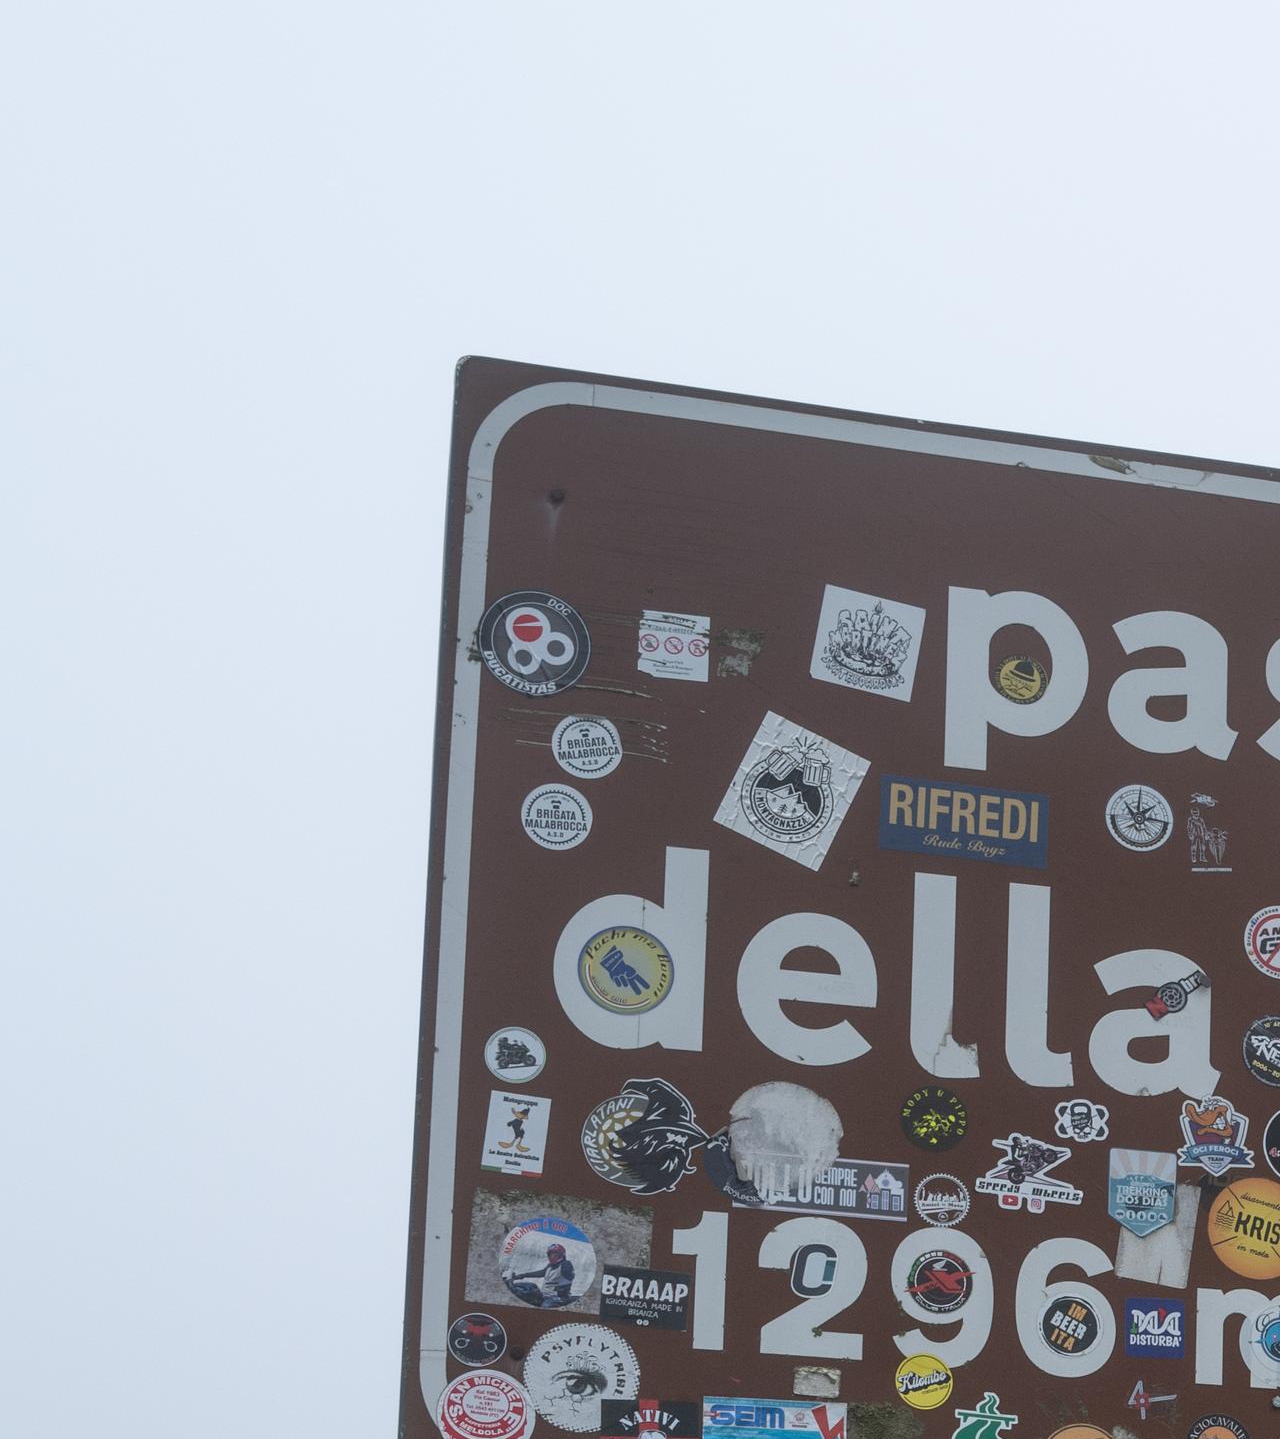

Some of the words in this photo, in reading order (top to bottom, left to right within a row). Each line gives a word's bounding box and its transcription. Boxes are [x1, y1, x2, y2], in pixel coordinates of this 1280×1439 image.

[483, 649, 558, 695] DUCATISTAS
[558, 745, 621, 760] MALABROCCA
[566, 736, 607, 749] BRIGATA
[536, 809, 577, 822] BRIGATA
[889, 781, 1040, 843] RIFREDI
[524, 818, 588, 832] MALABROCCA
[553, 846, 1222, 1100] della
[814, 1166, 858, 1189] SEMPRE
[814, 1184, 836, 1207] CON
[838, 1187, 857, 1208] NOI
[1117, 1185, 1168, 1199] TREKKING
[602, 1273, 689, 1302] BRAAAP
[672, 1210, 1116, 1378] 1296
[1050, 1311, 1087, 1341] BEER
[619, 1409, 682, 1432] NATIVI
